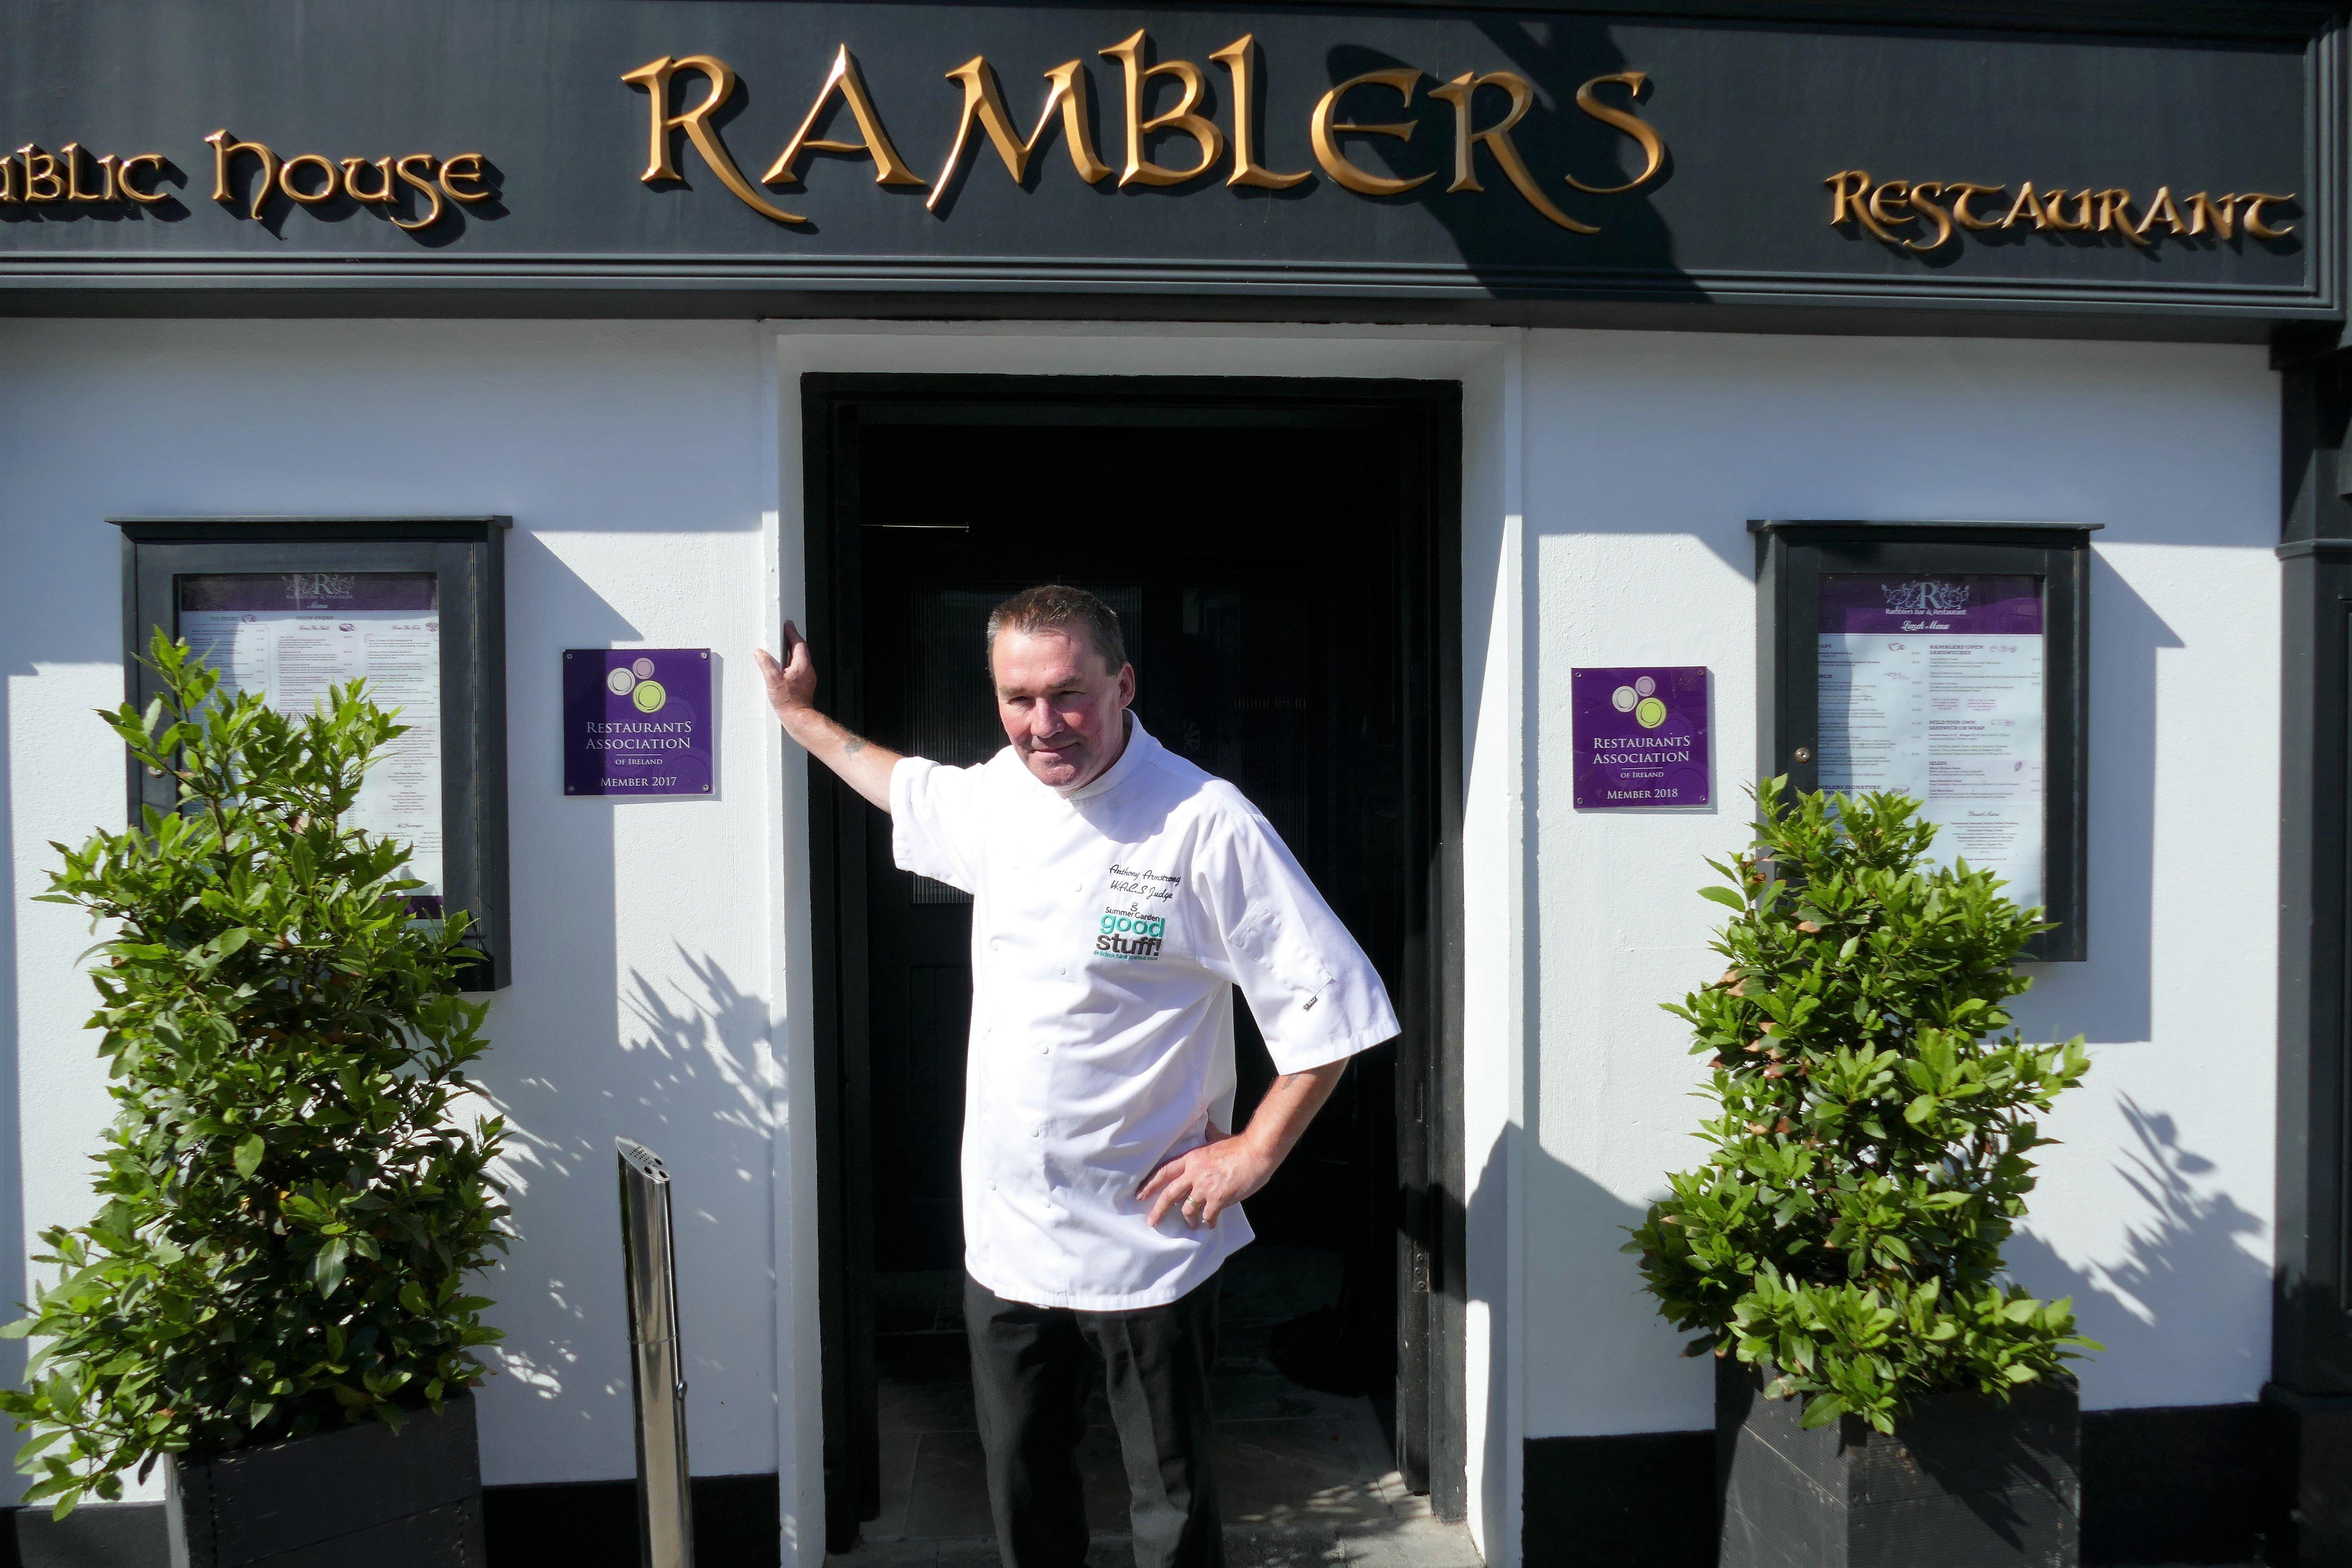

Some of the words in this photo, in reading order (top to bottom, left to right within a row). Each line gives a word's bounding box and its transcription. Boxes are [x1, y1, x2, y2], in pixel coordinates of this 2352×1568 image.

[621, 28, 1668, 236] RAMBLERS
[1823, 169, 2296, 252] RESTAURANT
[1901, 620, 1925, 631] Lunch
[1925, 620, 1950, 630] Menu
[586, 721, 692, 733] RESTAURANTS
[585, 737, 691, 750] ASSOCIATION
[1593, 735, 1691, 749] RESTAURANTS
[1592, 750, 1690, 764] ASSOCIATION
[600, 777, 649, 787] MEMBER
[652, 776, 677, 786] 2017
[1607, 790, 1652, 799] MEMBER
[1654, 788, 1678, 798] 2018
[1109, 864, 1140, 881] Anthony
[1142, 870, 1182, 887] Armstrong
[1146, 887, 1173, 903] Judge
[1105, 906, 1134, 917] Summer
[1135, 912, 1160, 922] Garden
[1100, 913, 1165, 938] good
[1096, 933, 1162, 956] stuff!
